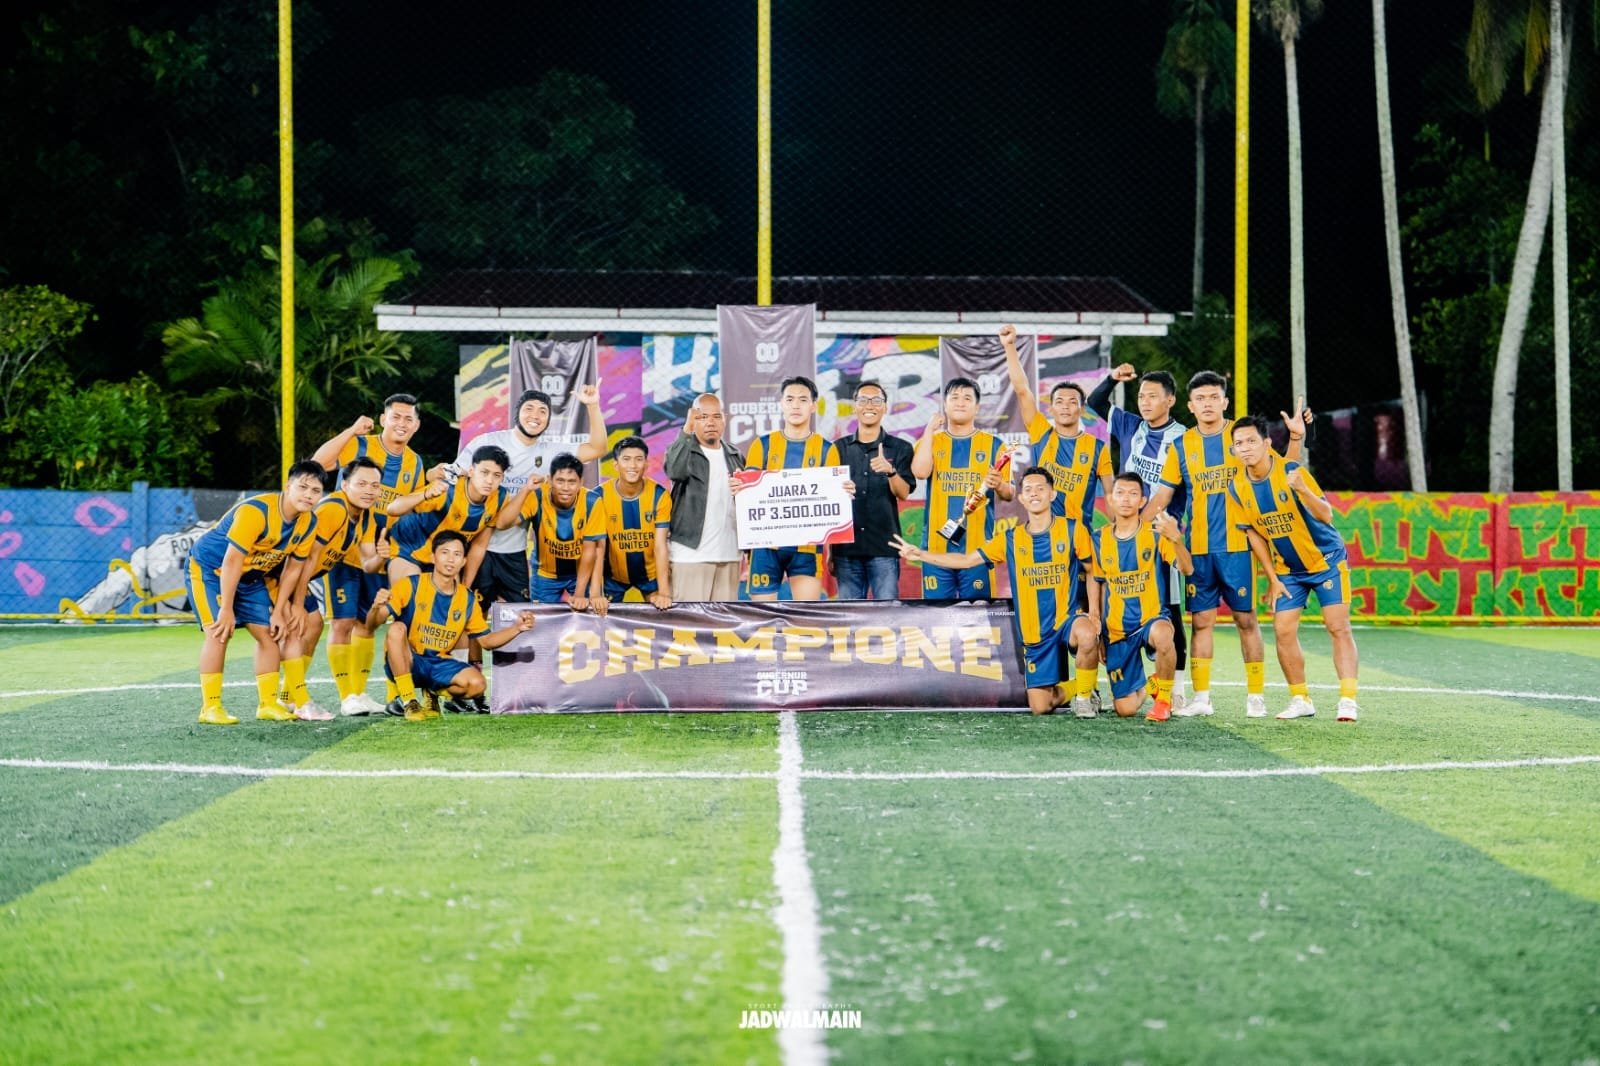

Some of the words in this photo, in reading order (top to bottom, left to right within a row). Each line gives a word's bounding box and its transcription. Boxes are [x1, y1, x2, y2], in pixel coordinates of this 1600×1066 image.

[936, 471, 981, 482] KINGSTER
[1194, 467, 1238, 482] KINGSTER
[768, 484, 807, 498] JUARA
[811, 483, 819, 495] 2
[748, 508, 766, 521] RP
[770, 503, 841, 520] 3.500.000
[612, 532, 655, 541] KINGSTER
[1332, 500, 1491, 565] MINI
[619, 541, 649, 550] UNITED
[1021, 563, 1066, 577] KINGSTER
[751, 574, 770, 588] 89
[923, 576, 938, 590] 10
[1029, 574, 1061, 587] UNITED
[335, 588, 347, 604] 5
[1115, 582, 1146, 595] UNITED
[417, 624, 457, 641] KINGSTER
[420, 635, 449, 650] UNITED
[557, 626, 1003, 685] CHAMPIONE
[756, 680, 808, 698] CUP
